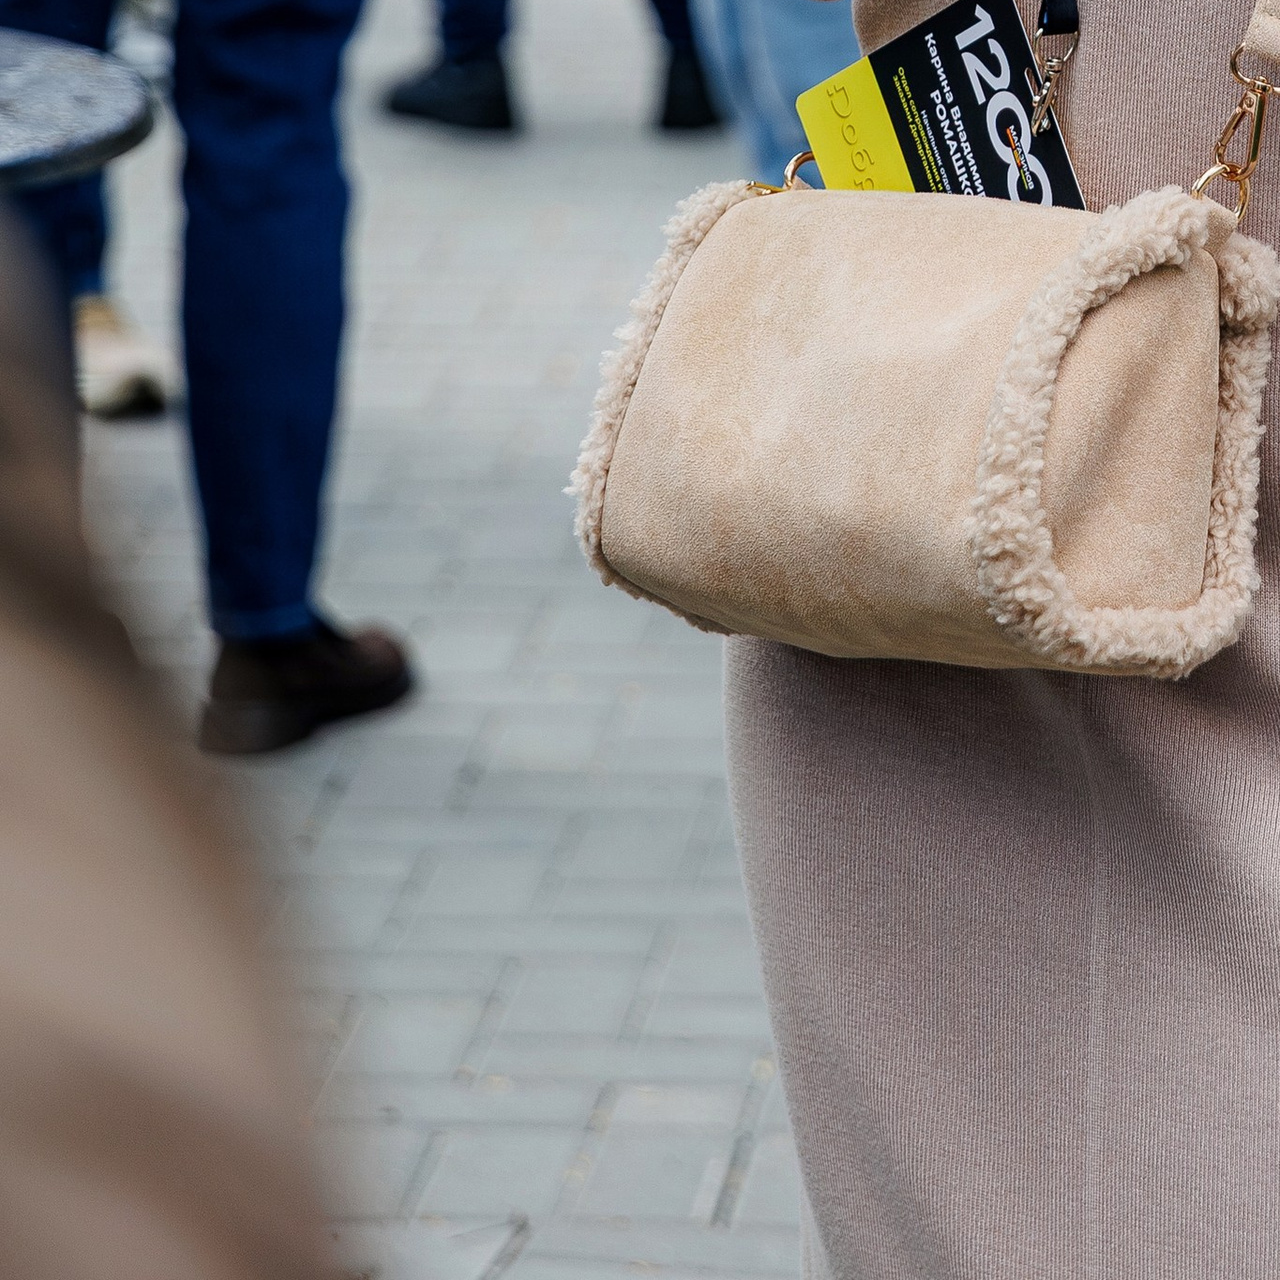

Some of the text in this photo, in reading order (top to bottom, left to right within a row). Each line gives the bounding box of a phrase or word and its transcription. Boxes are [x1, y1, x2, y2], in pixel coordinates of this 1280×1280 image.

[924, 32, 954, 104] Карина
[892, 74, 938, 193] заказами Департамент
[898, 66, 913, 99] Отдел
[909, 99, 941, 185] сопровождения
[920, 109, 943, 167] Начальник
[1008, 124, 1035, 190] МАГАЗИНОВ
